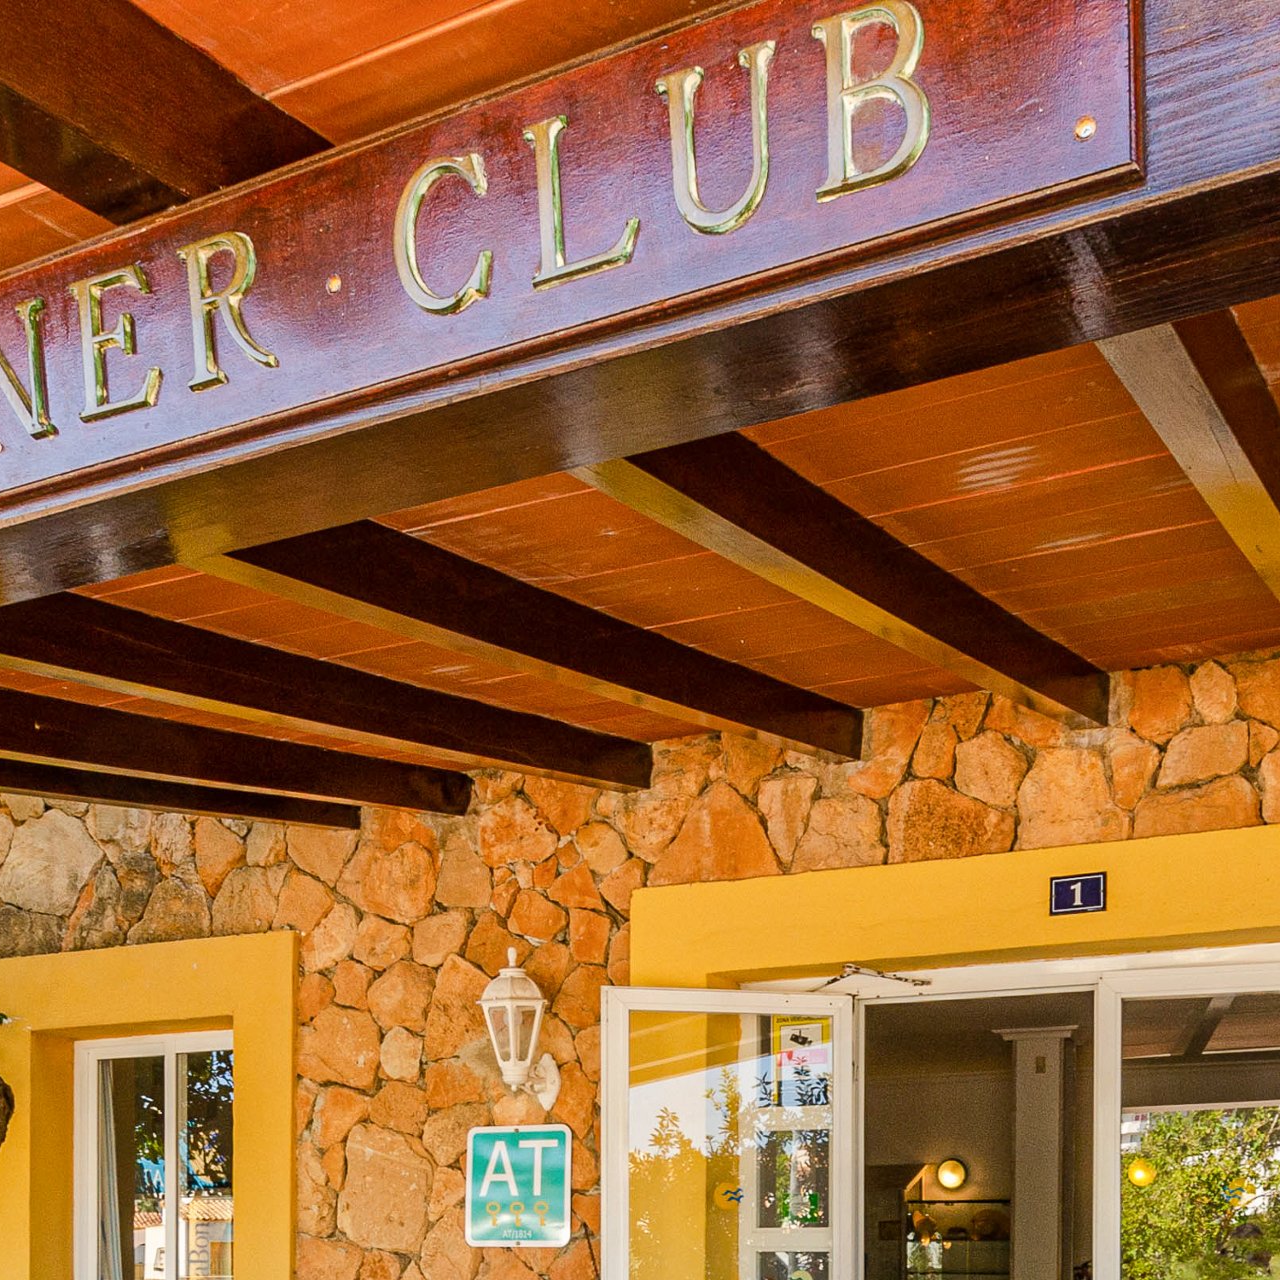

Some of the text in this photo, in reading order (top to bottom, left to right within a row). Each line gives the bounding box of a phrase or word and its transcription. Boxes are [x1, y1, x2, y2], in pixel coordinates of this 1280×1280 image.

[393, 0, 931, 316] CLUB
[1070, 881, 1083, 906] 1
[479, 1139, 559, 1197] AT
